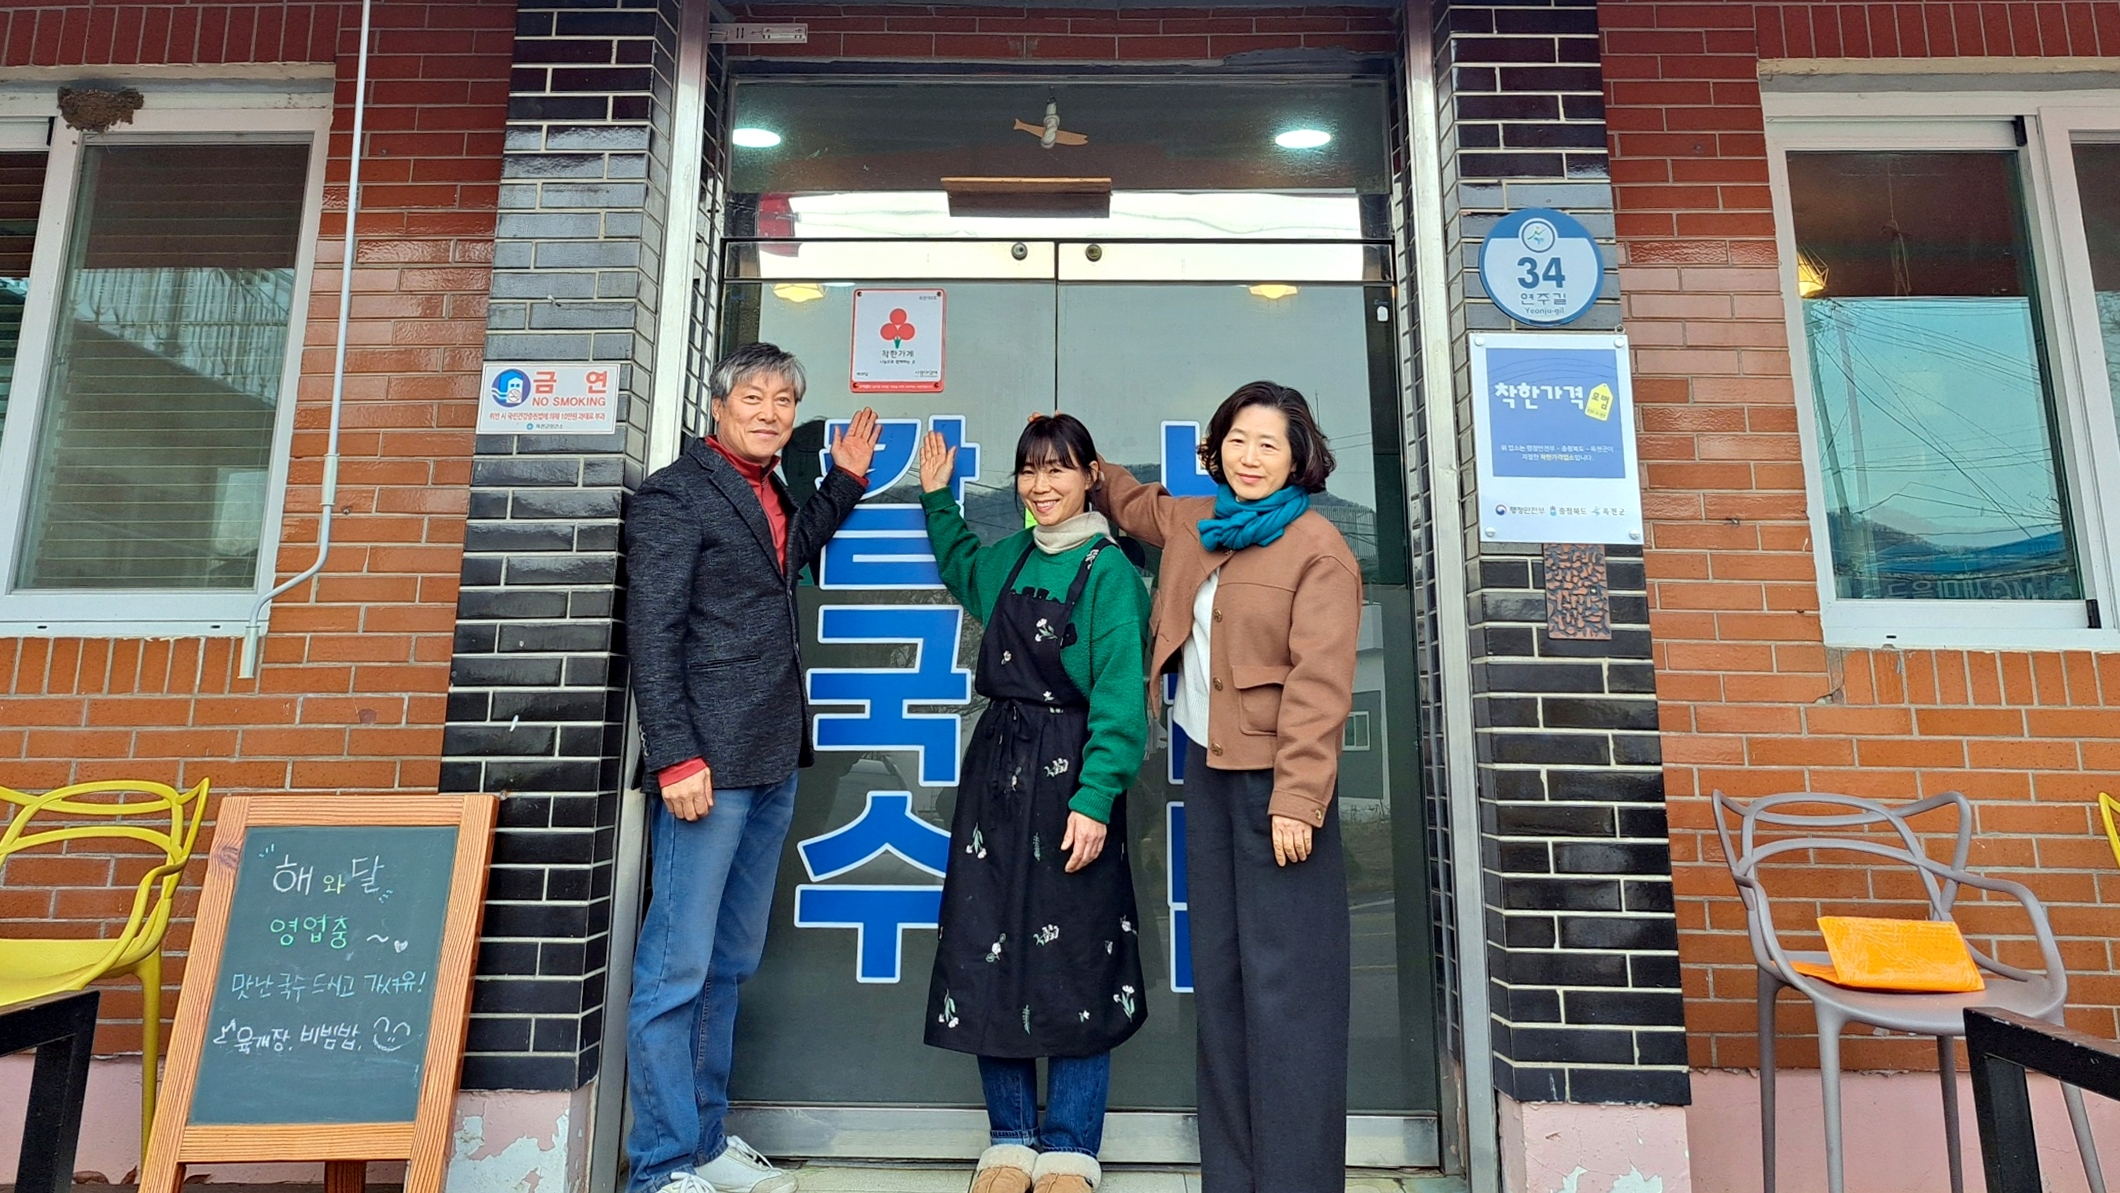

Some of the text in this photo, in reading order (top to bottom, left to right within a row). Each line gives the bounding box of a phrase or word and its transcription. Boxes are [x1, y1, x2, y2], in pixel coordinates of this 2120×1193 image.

[1517, 257, 1566, 289] 34
[1520, 293, 1567, 305] 연주길
[1524, 307, 1565, 315] Yeonju-gil
[882, 349, 914, 358] 착한가게
[532, 397, 606, 407] NO SMOKING
[1494, 382, 1584, 410] 착한가격
[1558, 506, 1587, 515] 충청북도
[270, 914, 349, 949] 영업중
[232, 973, 274, 1000] 맛난
[277, 973, 307, 1002] 국수
[311, 973, 355, 997] 드시고
